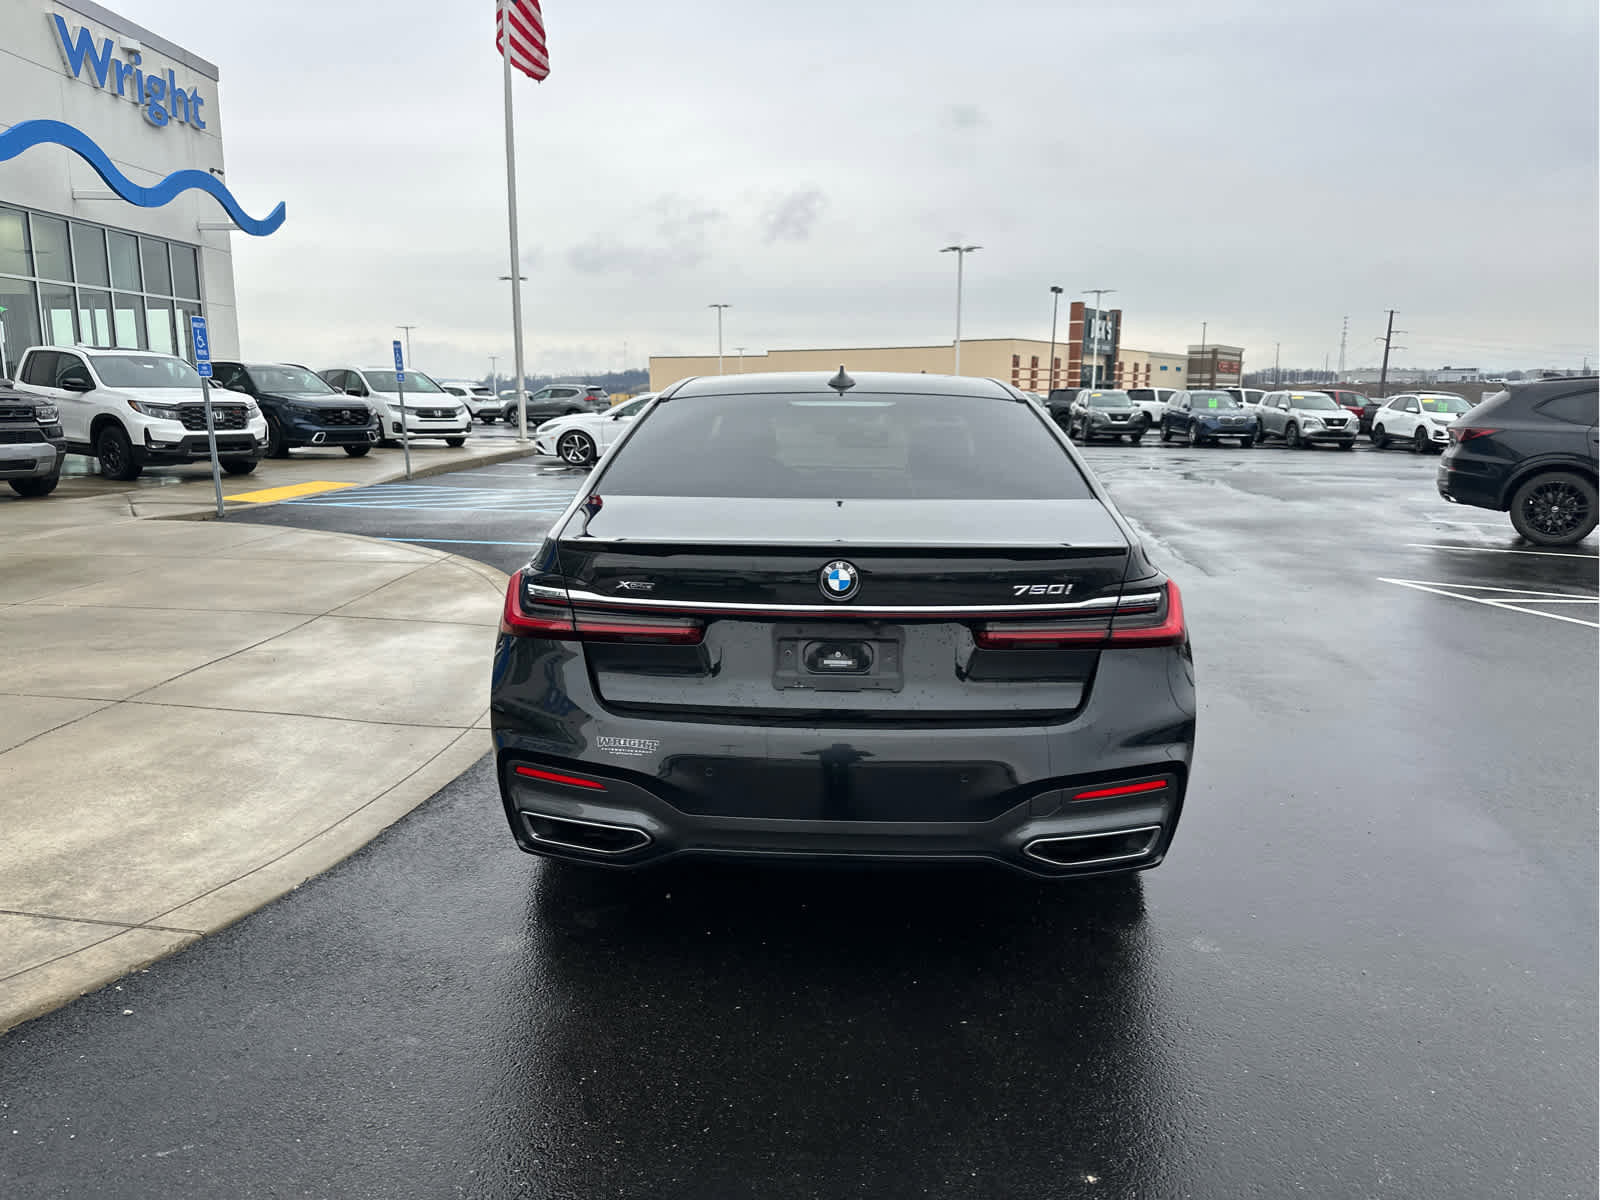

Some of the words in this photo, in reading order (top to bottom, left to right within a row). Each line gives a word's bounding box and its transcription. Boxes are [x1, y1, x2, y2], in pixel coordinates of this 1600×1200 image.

[50, 13, 207, 129] Wright
[823, 561, 856, 575] BMW
[596, 735, 660, 752] WRIGHT
